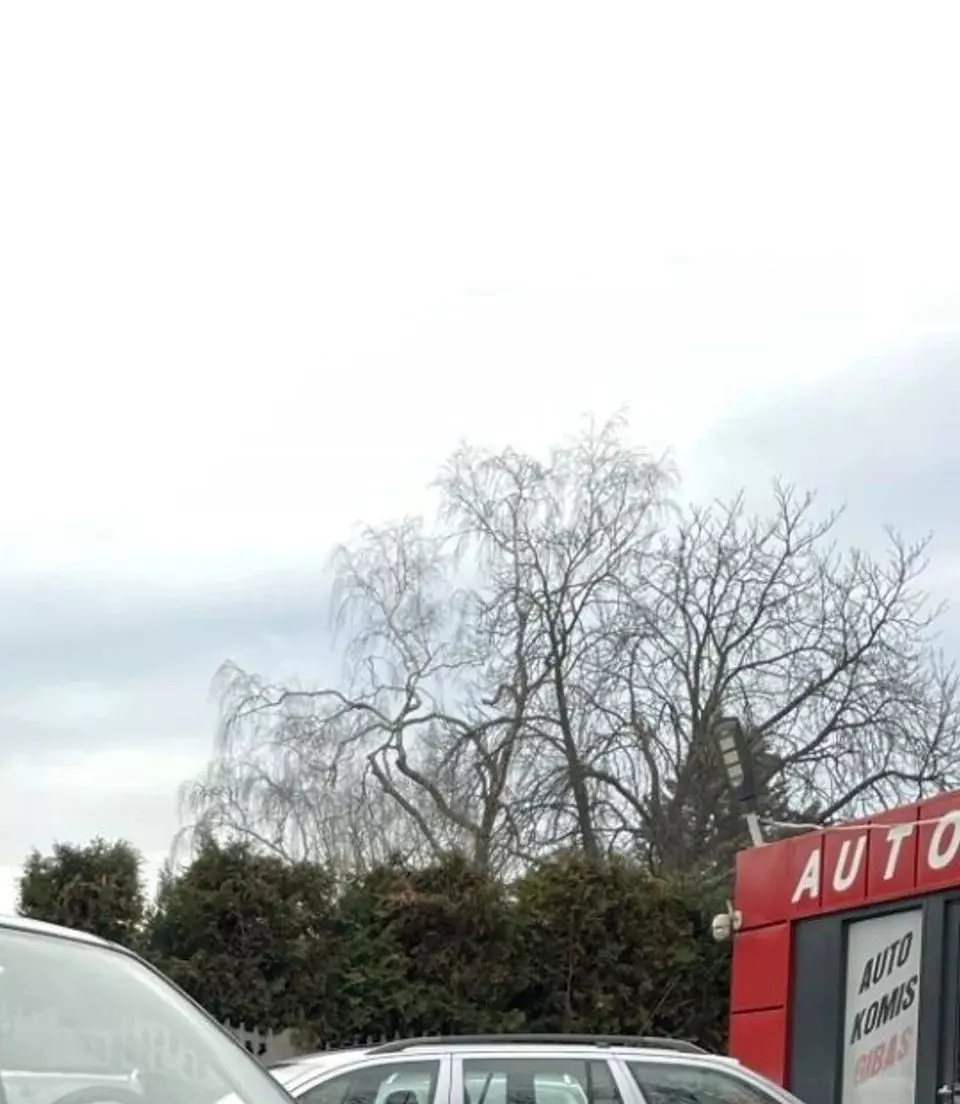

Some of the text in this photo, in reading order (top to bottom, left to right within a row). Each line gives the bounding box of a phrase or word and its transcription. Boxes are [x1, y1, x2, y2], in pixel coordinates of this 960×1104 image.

[791, 810, 960, 904] AUTO
[858, 931, 913, 996] AUTO
[850, 974, 918, 1046] KOMIS
[854, 1025, 913, 1088] GIBAS
